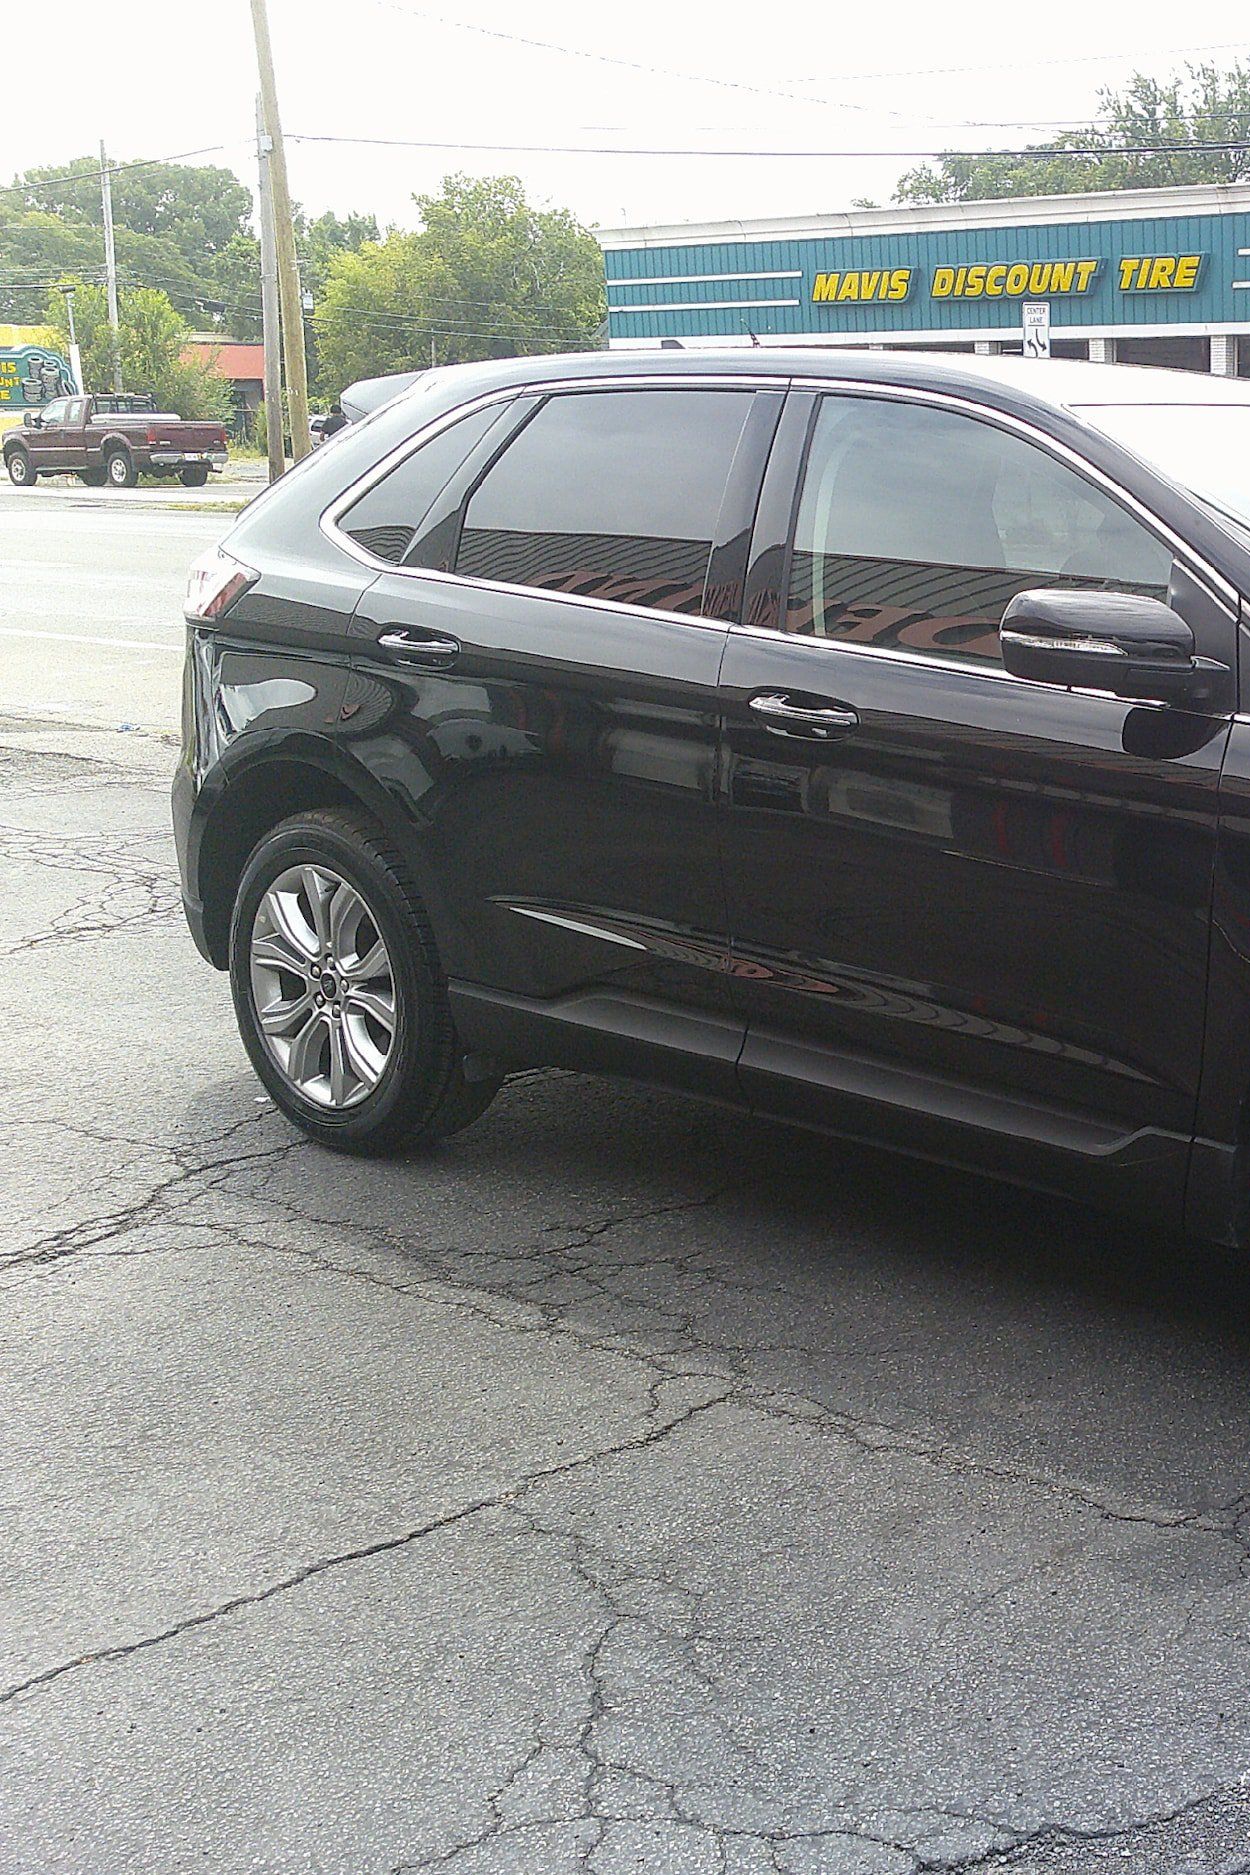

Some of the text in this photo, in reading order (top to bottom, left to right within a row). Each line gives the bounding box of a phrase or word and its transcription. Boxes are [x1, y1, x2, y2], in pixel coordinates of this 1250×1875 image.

[812, 255, 1201, 302] MAVIS DISCOUNT TIRE
[1027, 307, 1046, 315] CENTER
[0, 362, 16, 373] IS
